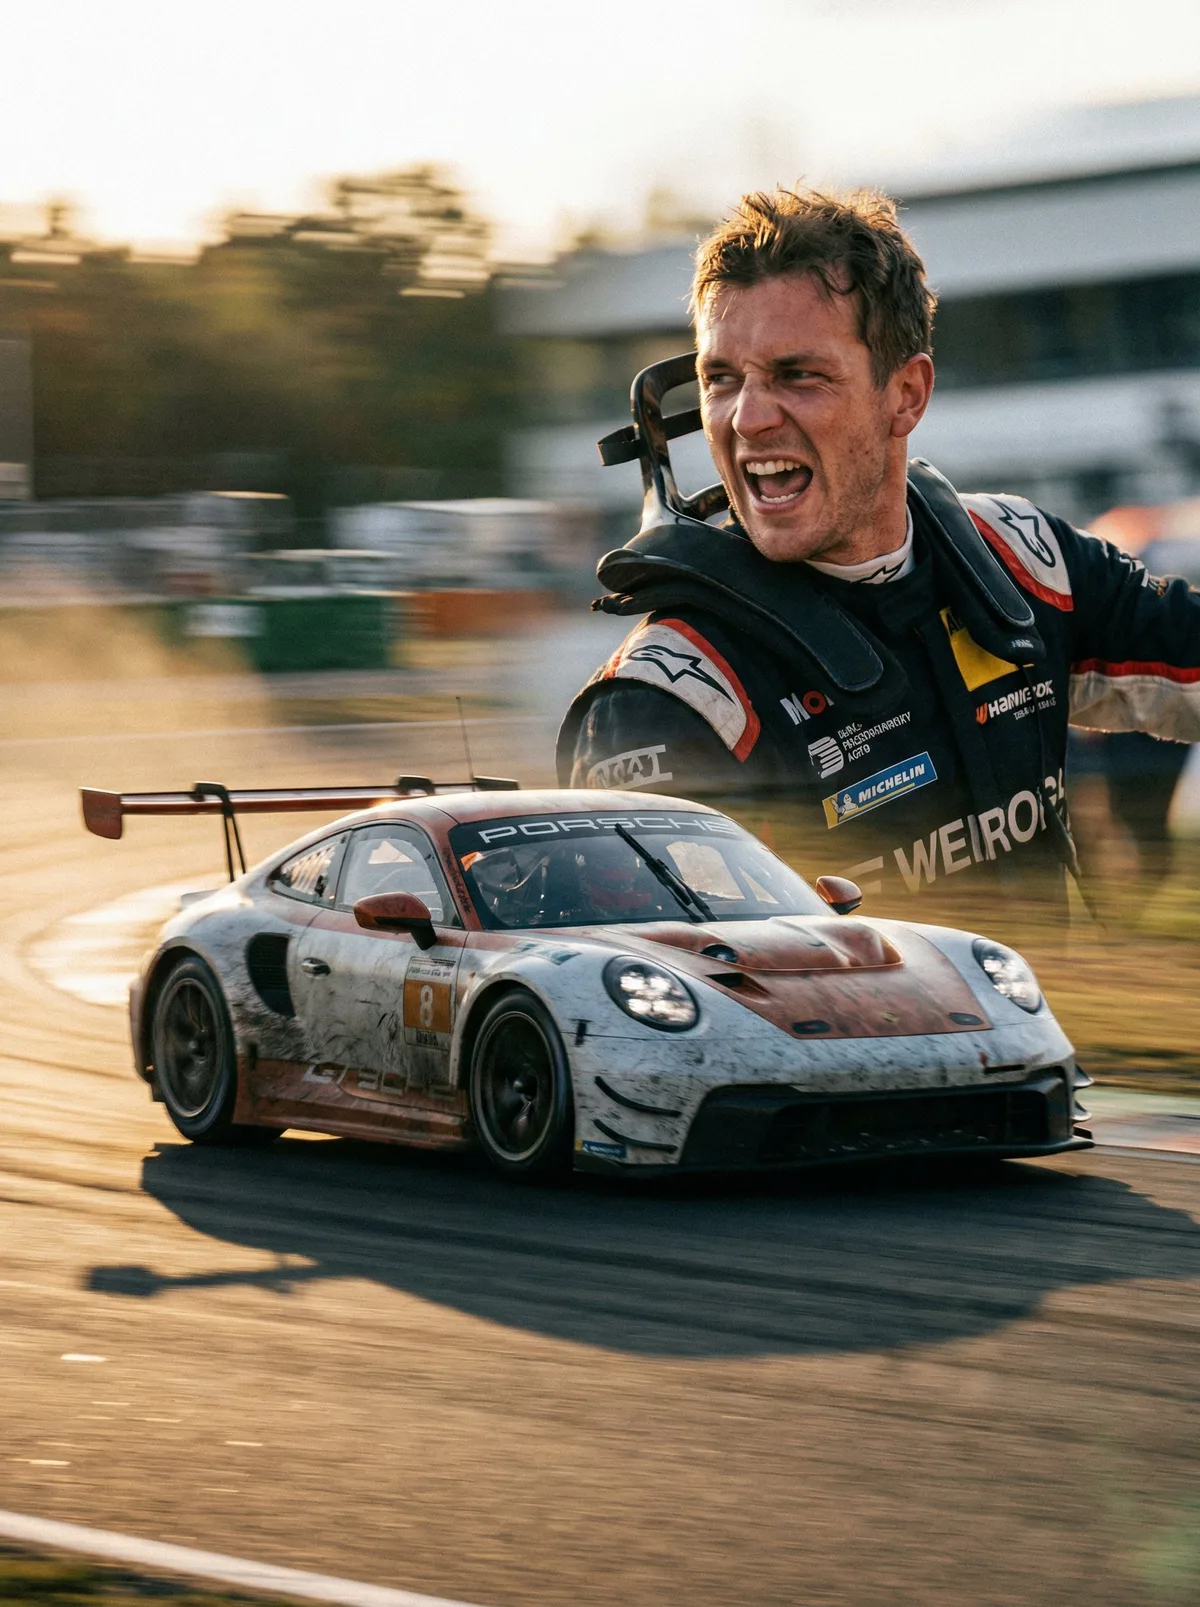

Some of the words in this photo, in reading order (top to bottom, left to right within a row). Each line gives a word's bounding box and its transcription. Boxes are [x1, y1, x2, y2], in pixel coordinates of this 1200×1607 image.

[858, 763, 925, 804] MICHELIN
[478, 816, 740, 844] PORSCHE
[419, 984, 434, 1027] 8
